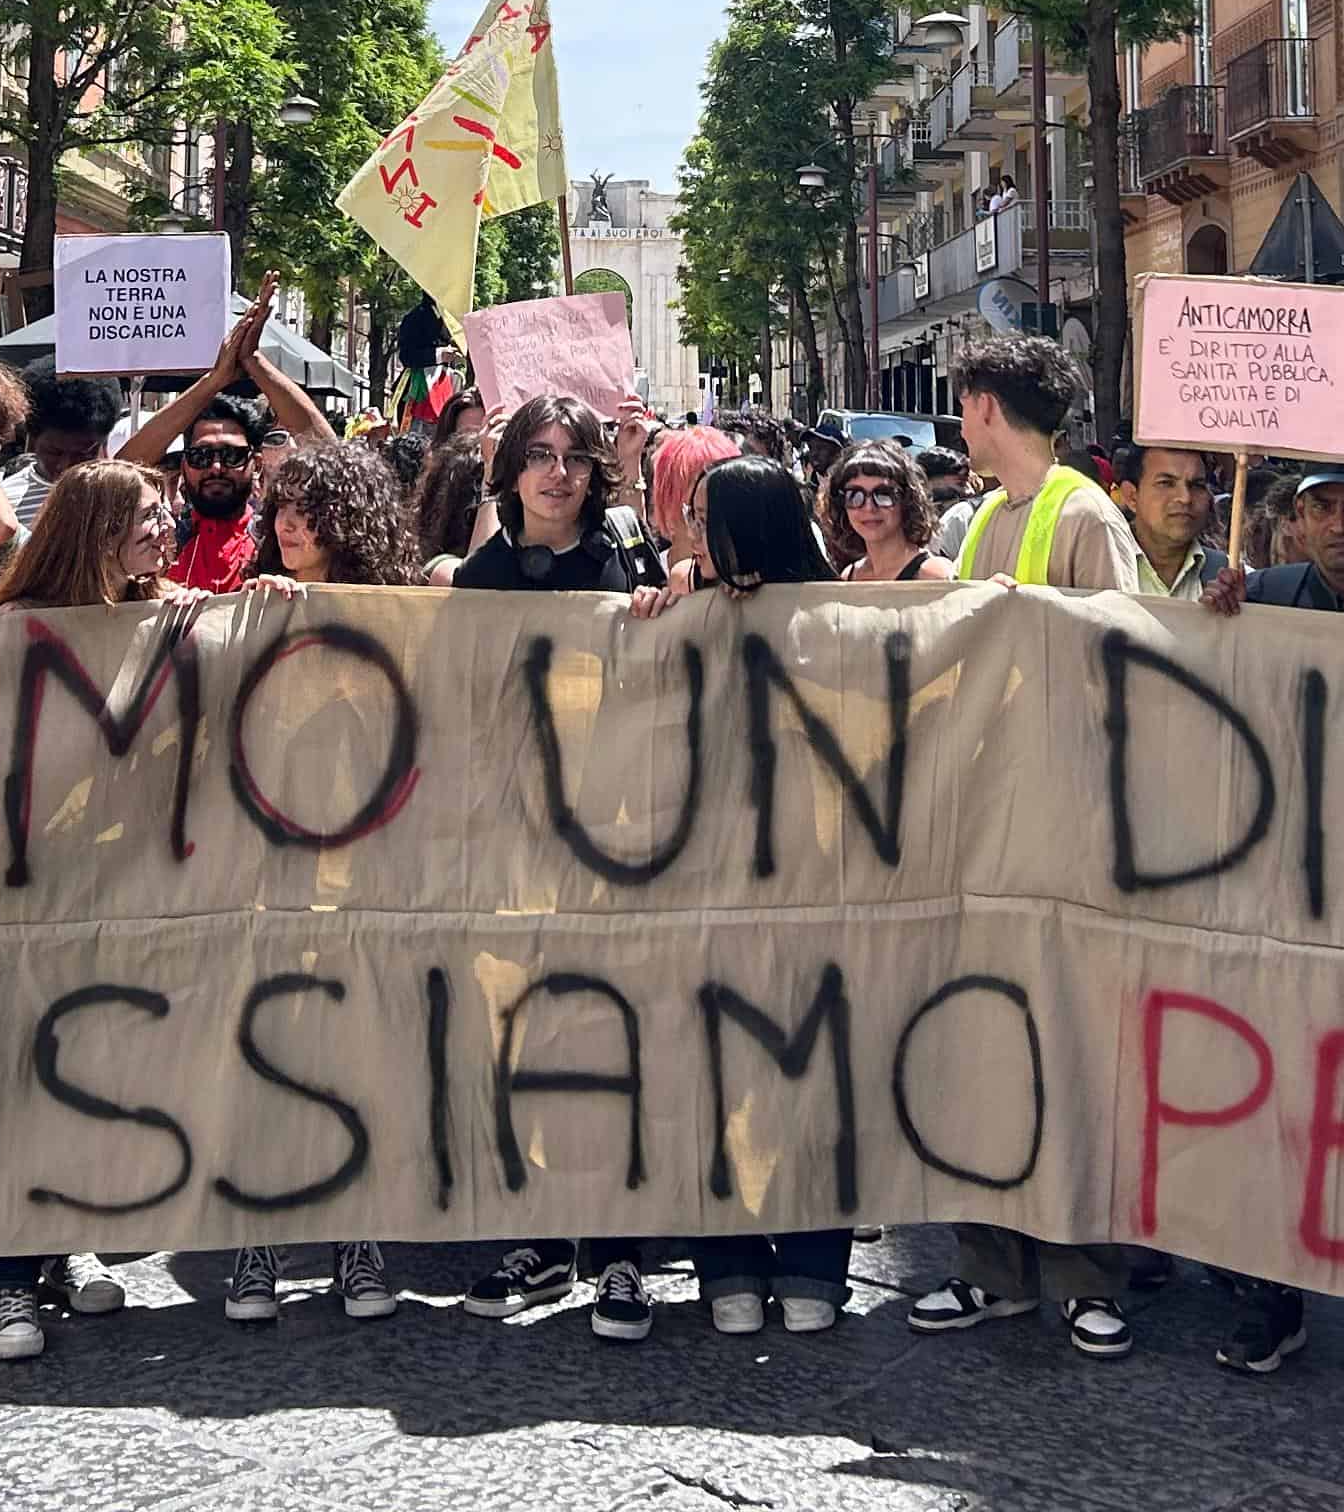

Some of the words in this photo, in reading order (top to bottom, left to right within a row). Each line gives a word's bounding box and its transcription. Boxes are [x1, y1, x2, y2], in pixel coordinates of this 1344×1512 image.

[605, 228, 632, 238] SUOI
[85, 270, 107, 284] LA
[113, 268, 187, 283] NOSTRA
[106, 287, 166, 302] TERRA
[89, 306, 127, 321] NON
[133, 303, 145, 320] È
[150, 305, 187, 319] UNA
[1177, 296, 1312, 334] ANTICAMORRA
[89, 324, 186, 340] DISCARICA
[1190, 339, 1267, 359] DIRITTO
[1273, 344, 1315, 363] ALLA
[1179, 384, 1258, 402] GRATUITA
[1265, 386, 1276, 401] E
[1285, 387, 1301, 402] DI
[519, 631, 916, 887] UN
